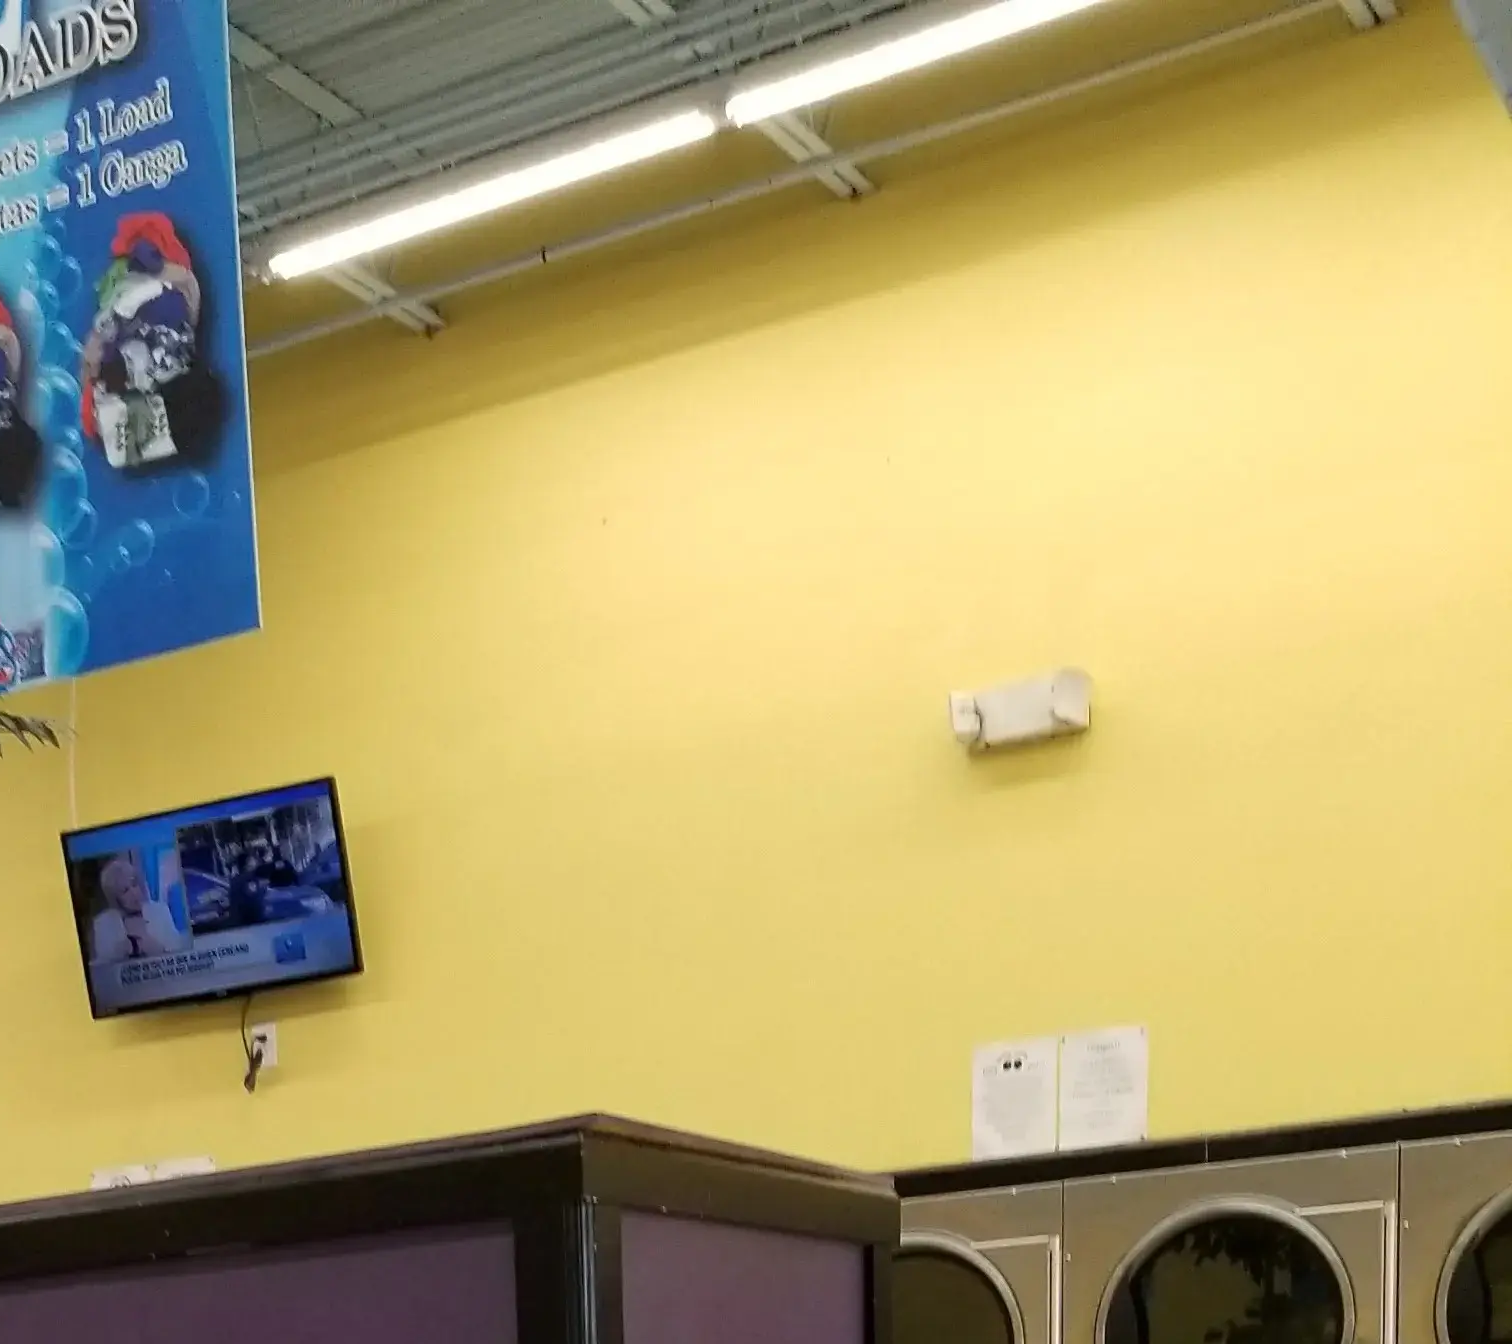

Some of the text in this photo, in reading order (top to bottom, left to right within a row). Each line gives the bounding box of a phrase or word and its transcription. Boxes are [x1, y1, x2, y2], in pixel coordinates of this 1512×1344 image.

[73, 109, 93, 154] 1
[98, 78, 172, 143] Load
[76, 162, 96, 208] 1
